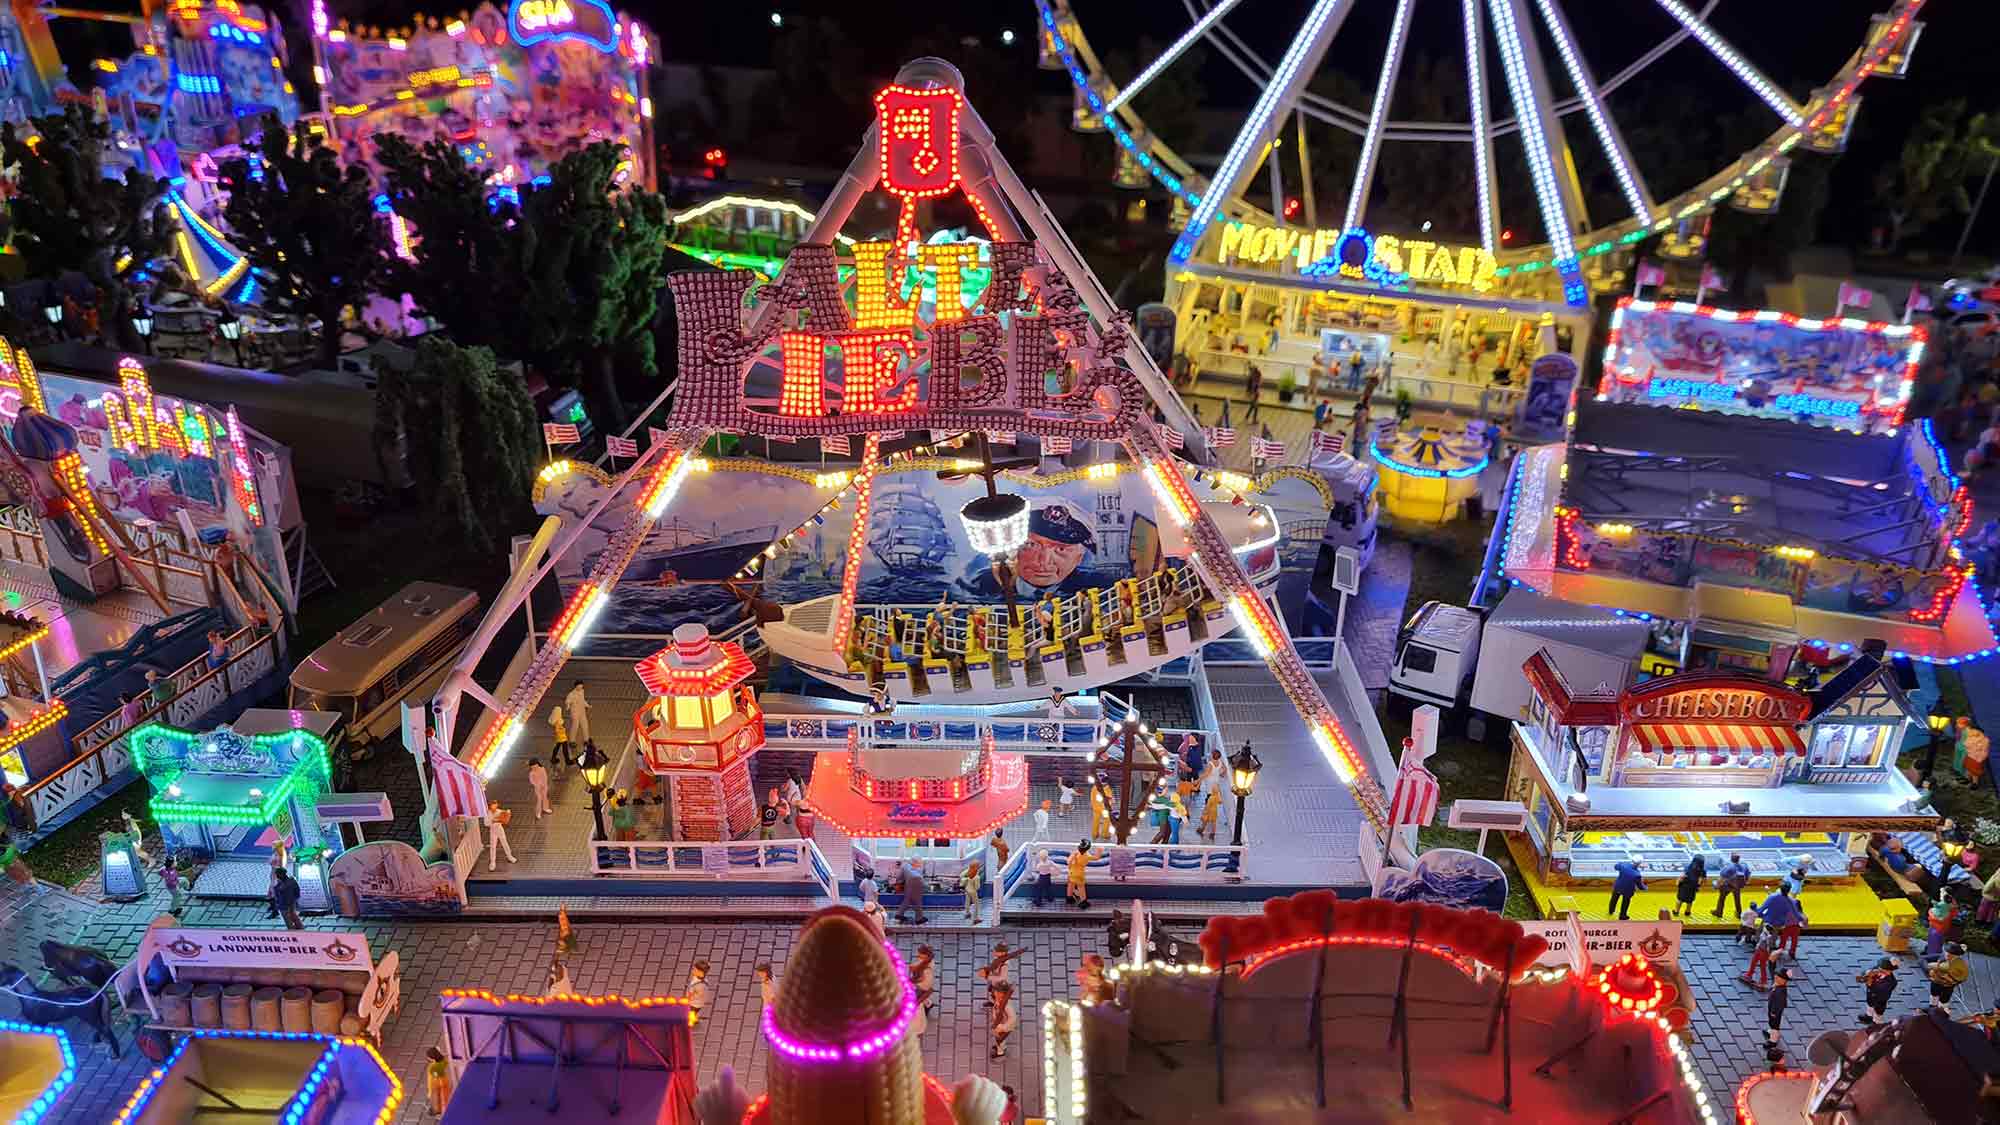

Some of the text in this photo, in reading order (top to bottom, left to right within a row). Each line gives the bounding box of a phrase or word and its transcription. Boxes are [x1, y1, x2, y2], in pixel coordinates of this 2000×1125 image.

[1373, 234, 1498, 293] STAR
[1636, 690, 1789, 719] CHEESEBOX
[1544, 929, 1619, 937] ROTURGER
[221, 935, 299, 943] ROTHENBURGER
[208, 944, 318, 955] LANDWEHR-BIER
